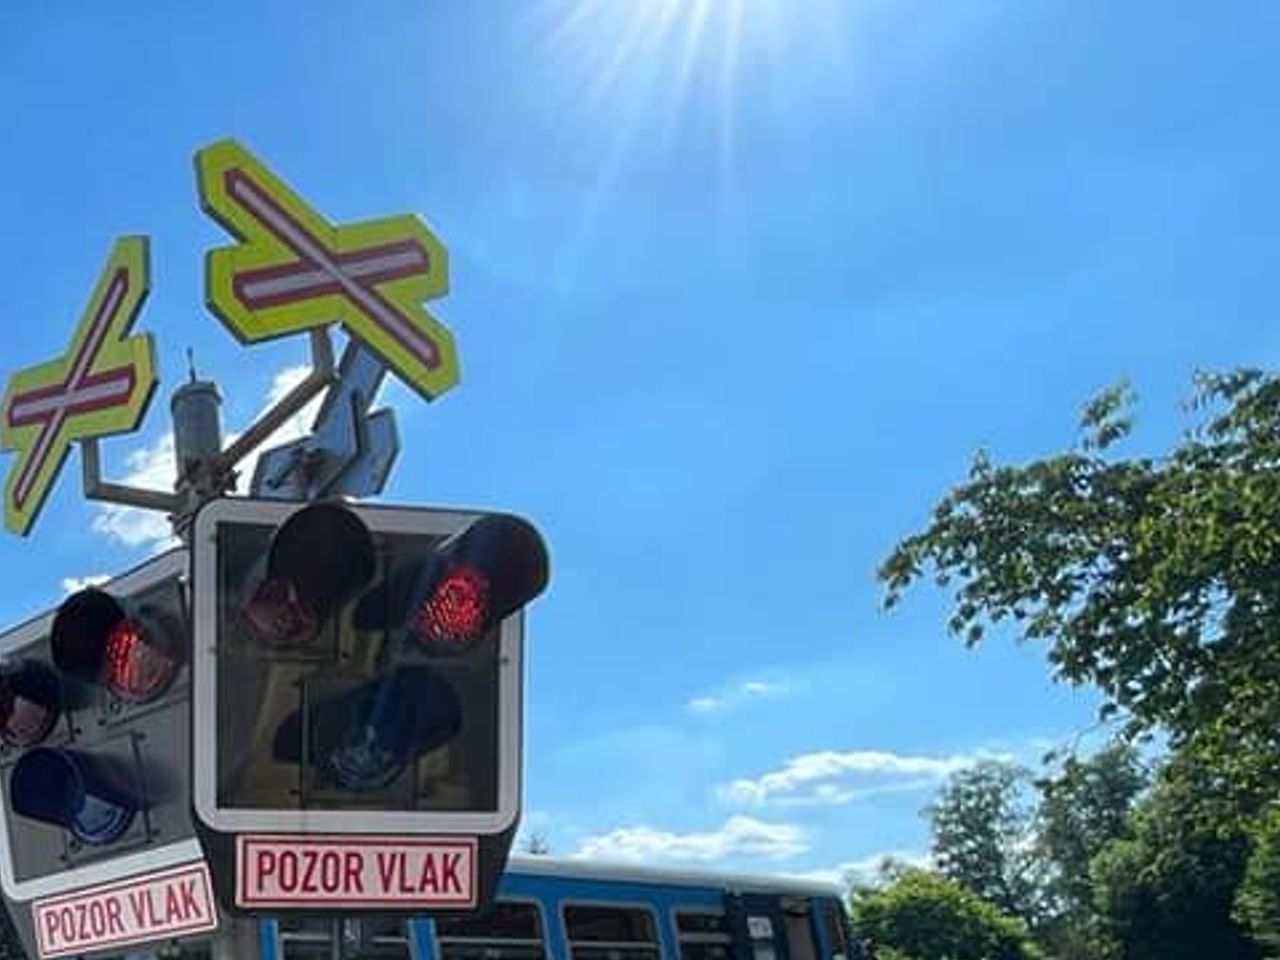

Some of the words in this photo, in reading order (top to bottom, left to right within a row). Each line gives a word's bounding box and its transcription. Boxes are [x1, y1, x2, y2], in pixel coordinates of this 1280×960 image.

[257, 850, 364, 893] POZOR
[377, 851, 463, 893] VLAK
[45, 896, 124, 945] POZOR
[129, 879, 202, 928] VLAK
